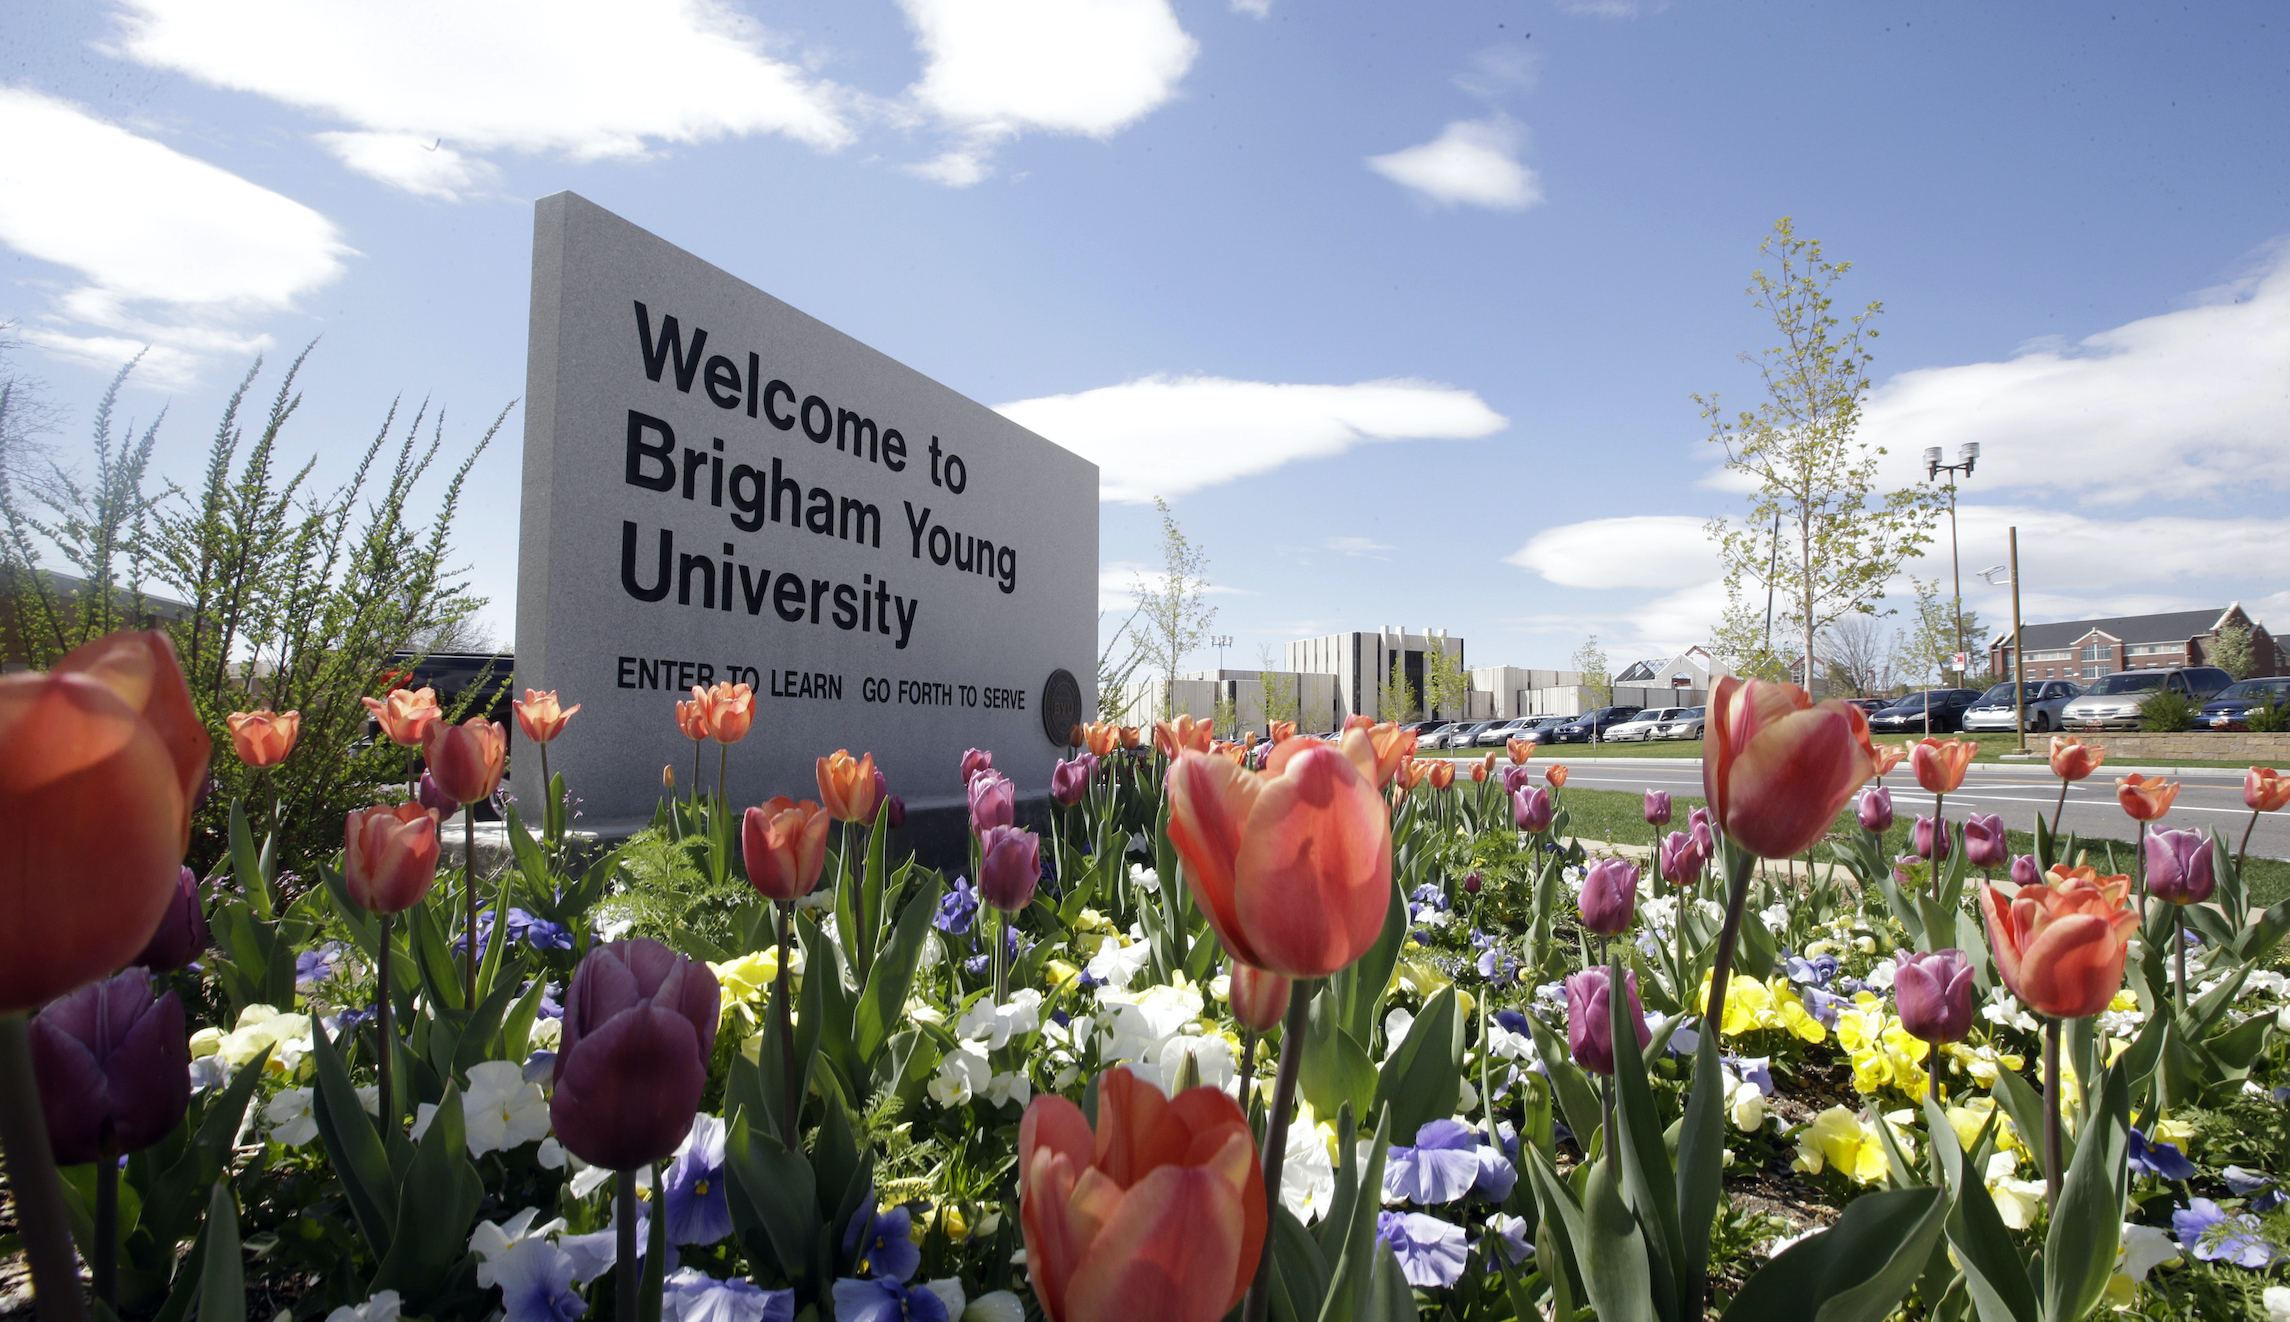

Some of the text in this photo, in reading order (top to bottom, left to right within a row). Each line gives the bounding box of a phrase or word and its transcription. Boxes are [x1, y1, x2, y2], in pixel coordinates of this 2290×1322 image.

[634, 300, 967, 495] Welcome to
[625, 409, 1016, 594] Brigham Young
[621, 520, 918, 649] University
[617, 656, 1025, 710] ENTER TO LEARN GO FORTH TO SERVE
[1054, 702, 1074, 715] BYU
